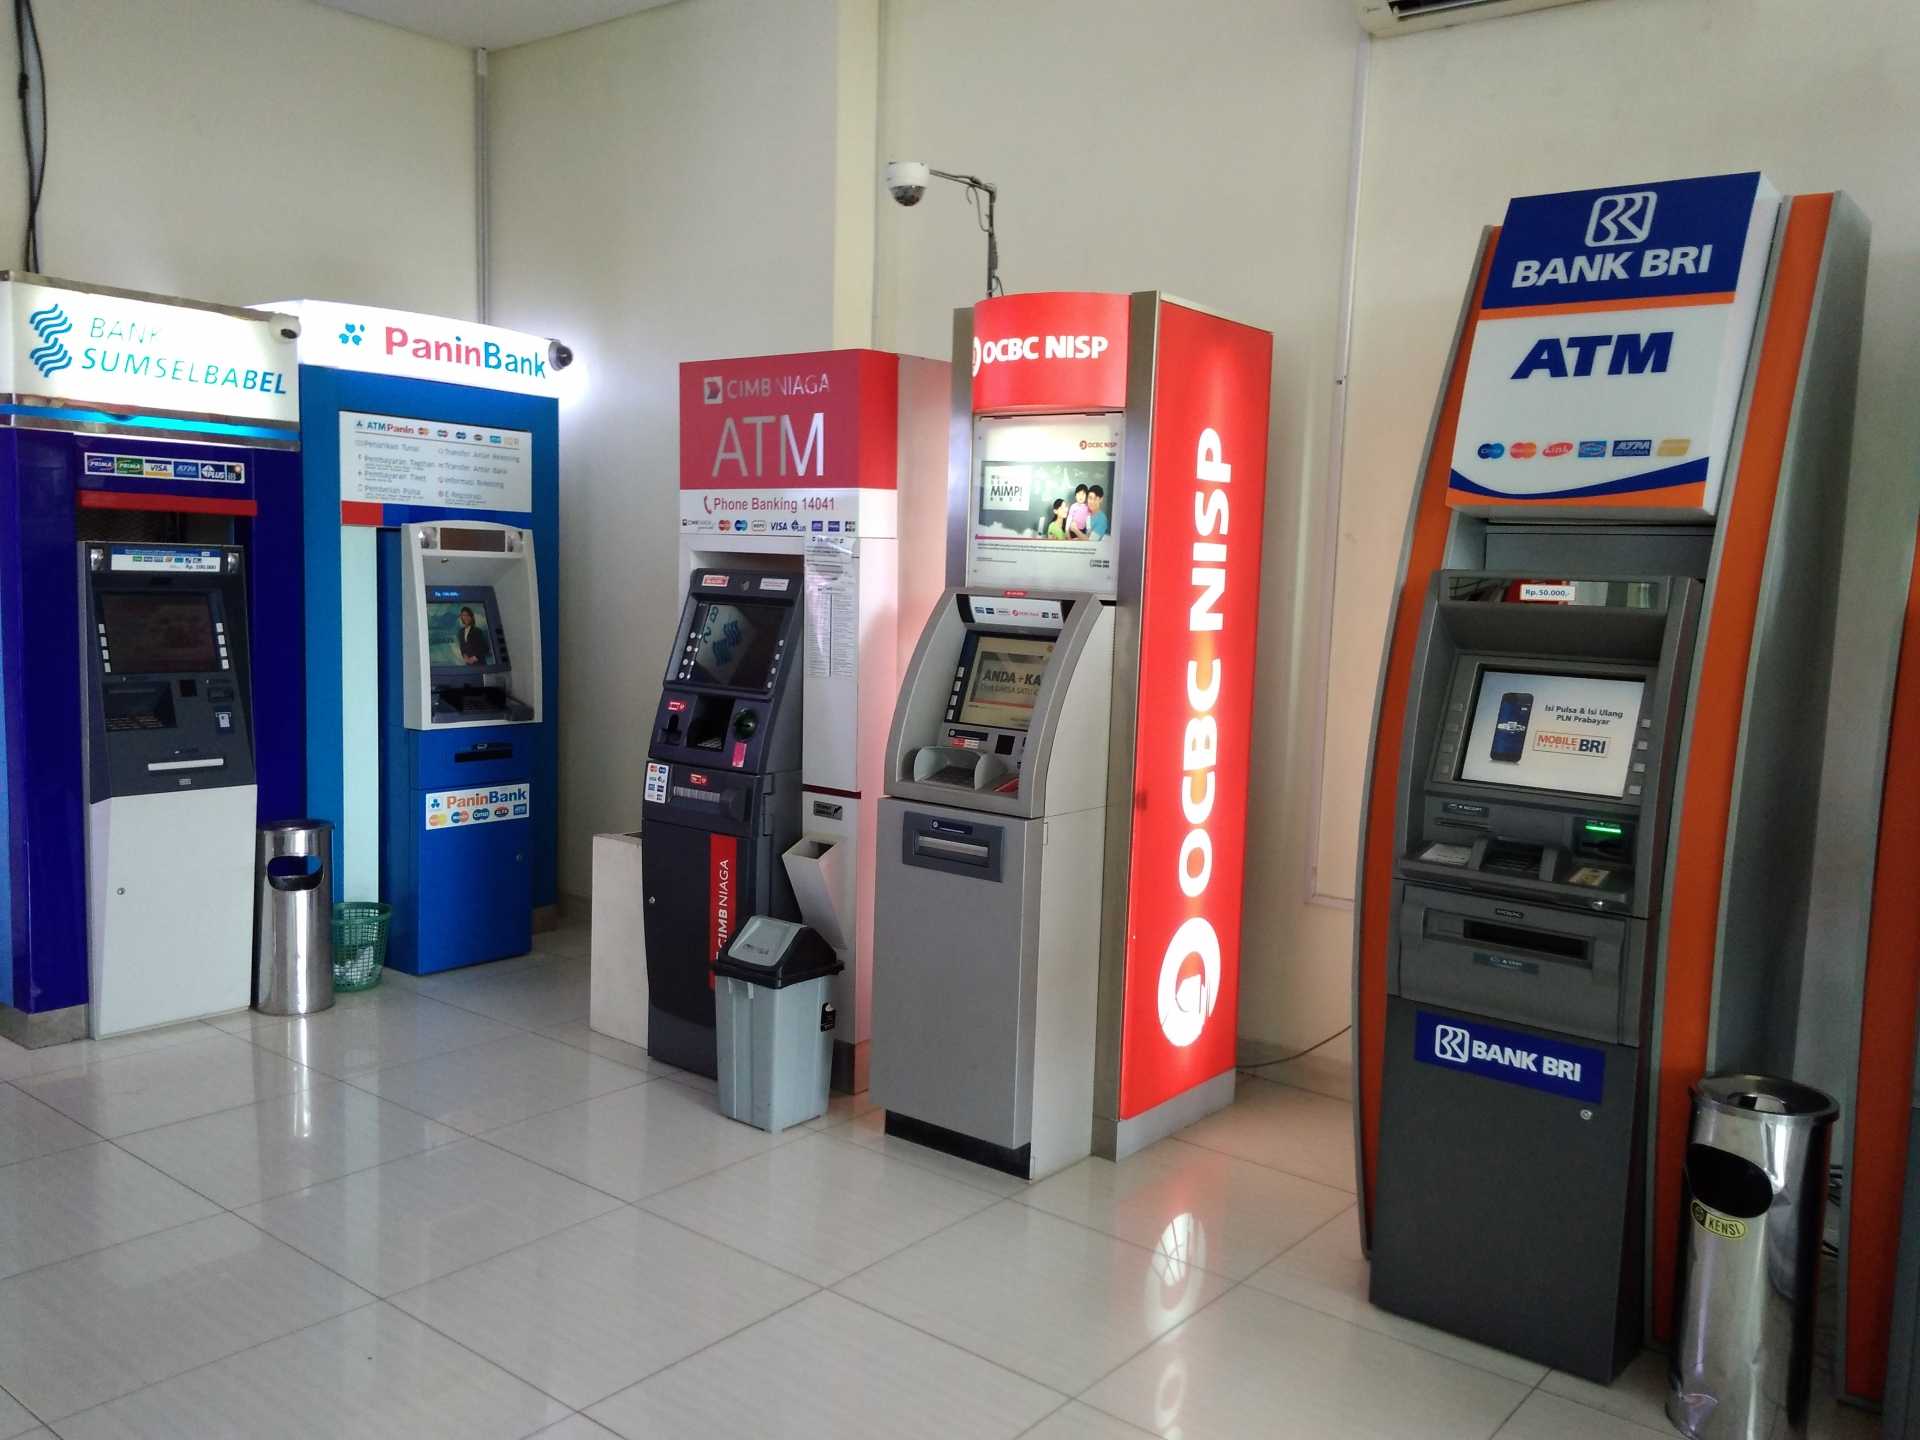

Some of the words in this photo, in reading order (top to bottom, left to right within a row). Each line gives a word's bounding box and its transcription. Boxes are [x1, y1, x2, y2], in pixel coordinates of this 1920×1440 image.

[1511, 250, 1634, 289] BANK
[1639, 244, 1713, 278] BRI
[385, 326, 546, 379] PaninBank
[982, 336, 1040, 364] OCBC
[1045, 335, 1109, 359] NISP
[1509, 331, 1674, 380] ATM
[82, 348, 287, 395] SUMSELBABEL
[727, 377, 770, 399] CIMB
[777, 373, 831, 396] NIAGA
[710, 411, 825, 478] ATM
[150, 464, 168, 472] VISA
[207, 471, 225, 479] PLUS
[713, 497, 748, 511] Phone
[751, 497, 798, 513] Banking
[802, 497, 836, 511] 14041
[770, 522, 788, 531] VISA
[1189, 428, 1232, 631] NISP
[982, 669, 1016, 683] ANDA
[1544, 704, 1555, 712] Isi
[1555, 705, 1577, 715] Pulsa
[1598, 709, 1624, 719] Ulang
[1555, 714, 1572, 722] PLN
[1573, 715, 1611, 726] Prabayar
[1537, 734, 1578, 746] MOBILE
[1579, 738, 1606, 754] BRI
[1178, 658, 1221, 897] OCBC
[446, 788, 528, 809] PaninBank
[718, 859, 729, 908] NIAGA
[1471, 1039, 1538, 1072] BANK
[1542, 1056, 1582, 1082] BRI
[1709, 1219, 1741, 1236] KENSI
